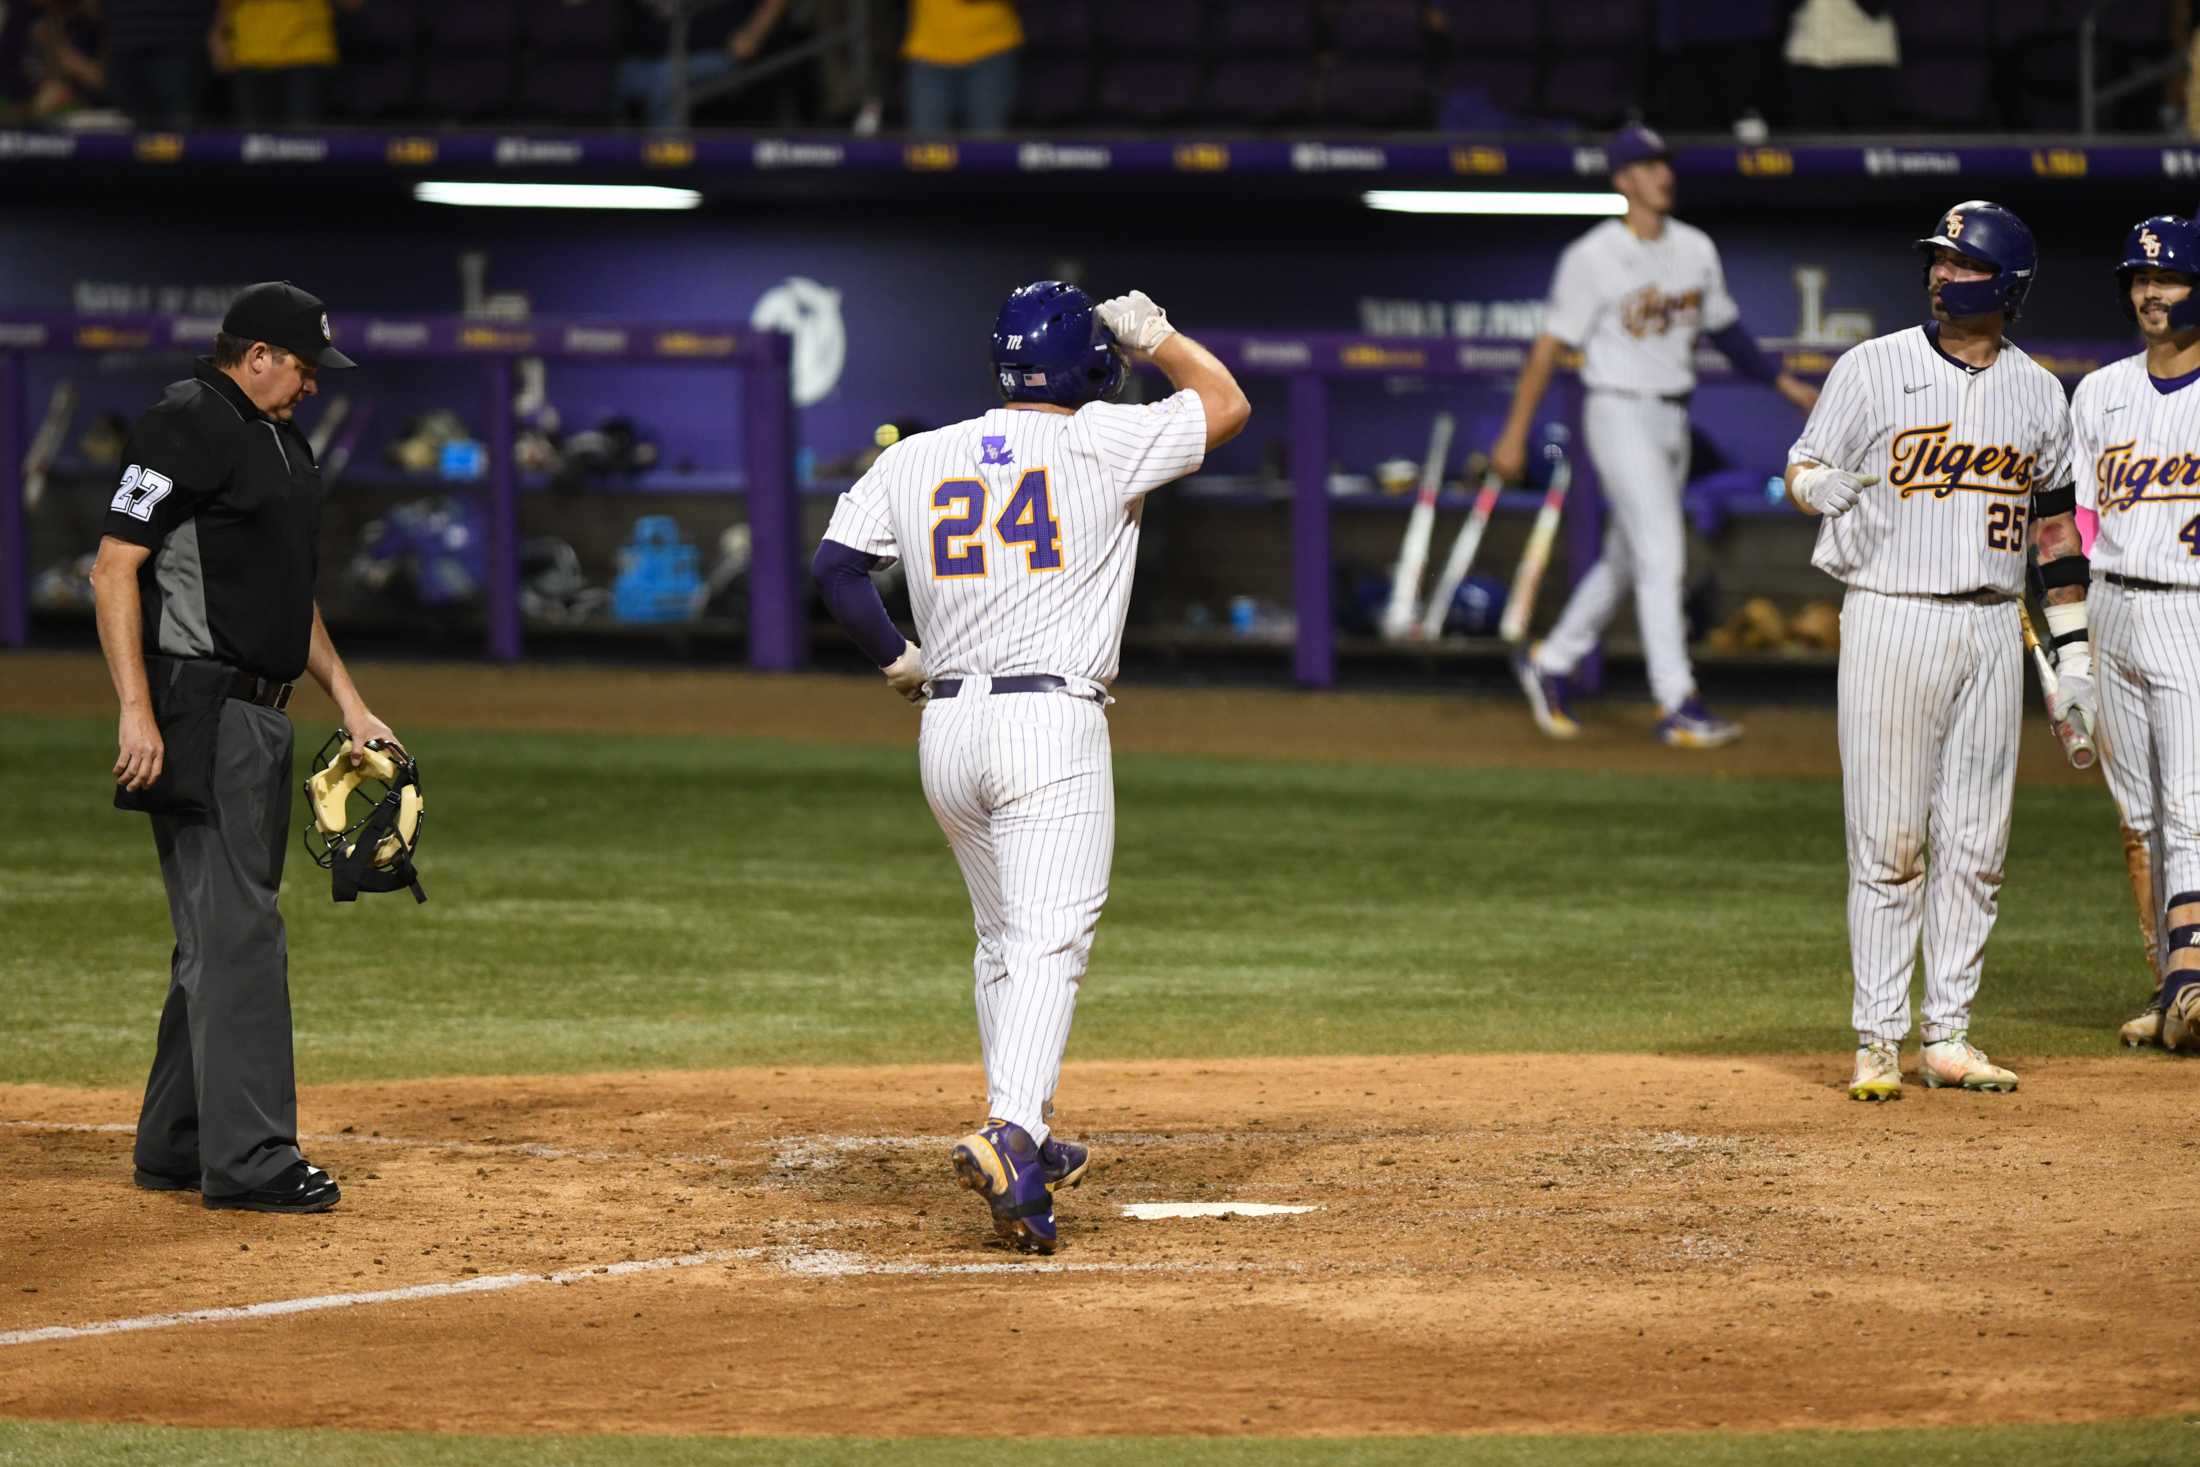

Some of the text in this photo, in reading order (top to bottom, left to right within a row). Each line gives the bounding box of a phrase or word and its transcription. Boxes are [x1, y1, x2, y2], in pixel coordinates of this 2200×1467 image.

[1946, 208, 1964, 239] LSU
[2139, 228, 2161, 257] LSU
[1000, 372, 1016, 387] 24
[1888, 422, 2038, 500] Tigers
[110, 463, 173, 522] 27
[930, 465, 1065, 580] 24
[1986, 501, 2027, 554] 25
